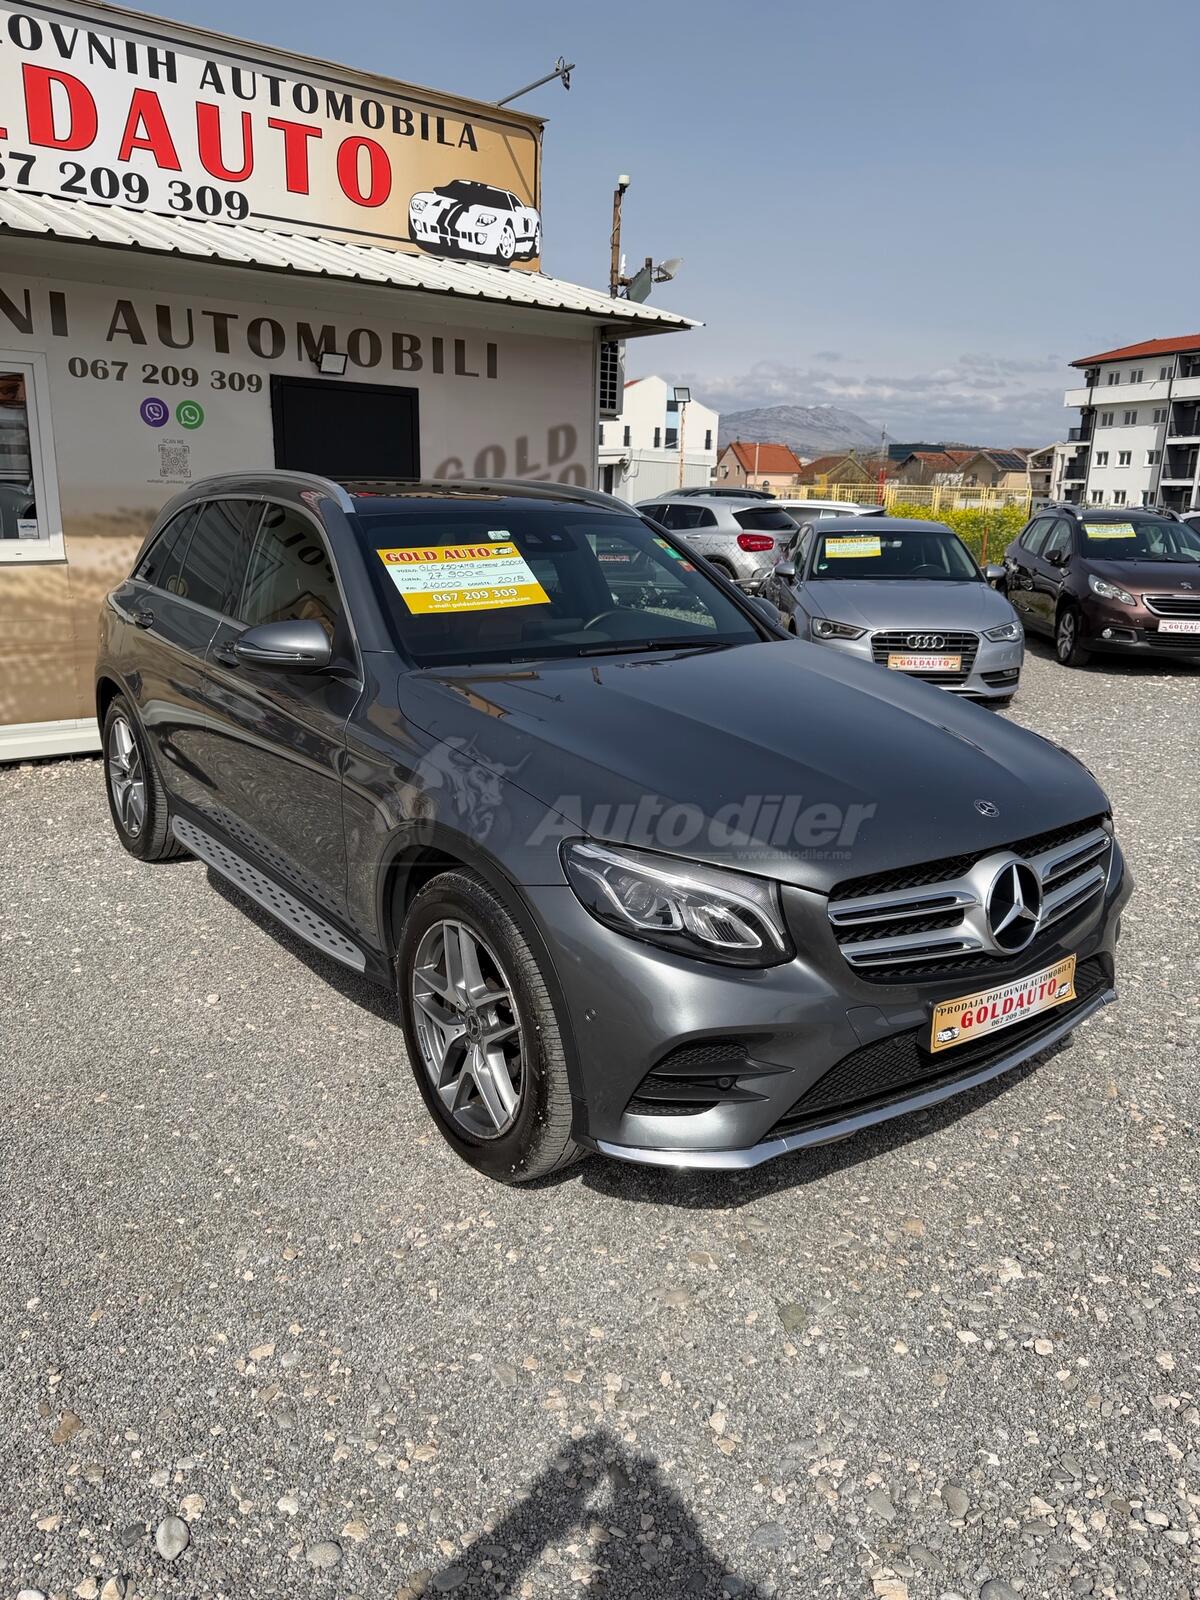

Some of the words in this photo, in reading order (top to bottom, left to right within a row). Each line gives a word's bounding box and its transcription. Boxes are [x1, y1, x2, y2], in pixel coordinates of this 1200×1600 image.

[0, 13, 177, 84] OVNIH
[199, 60, 478, 152] AUTOMOBILA
[0, 62, 392, 207] DAUTO
[58, 161, 149, 204] 209
[167, 180, 249, 221] 309
[105, 299, 498, 380] AUTOMOBILI
[67, 356, 129, 382] 067
[141, 363, 199, 388] 209
[209, 369, 263, 393] 309
[385, 550, 438, 562] GOLD
[444, 547, 491, 560] AUTO
[428, 571, 442, 580] 27
[432, 592, 458, 602] 067
[463, 590, 489, 600] 209
[492, 588, 518, 598] 309
[899, 659, 950, 667] GOLDAUTO
[940, 998, 984, 1016] PRODAJA
[987, 983, 1028, 1003] POLOVNIH
[1030, 962, 1072, 987] AUTOMOBILA
[960, 978, 1057, 1029] GOLDAUTO
[991, 1017, 1004, 1027] 067
[1005, 1012, 1018, 1022] 209
[1018, 1007, 1031, 1016] 309
